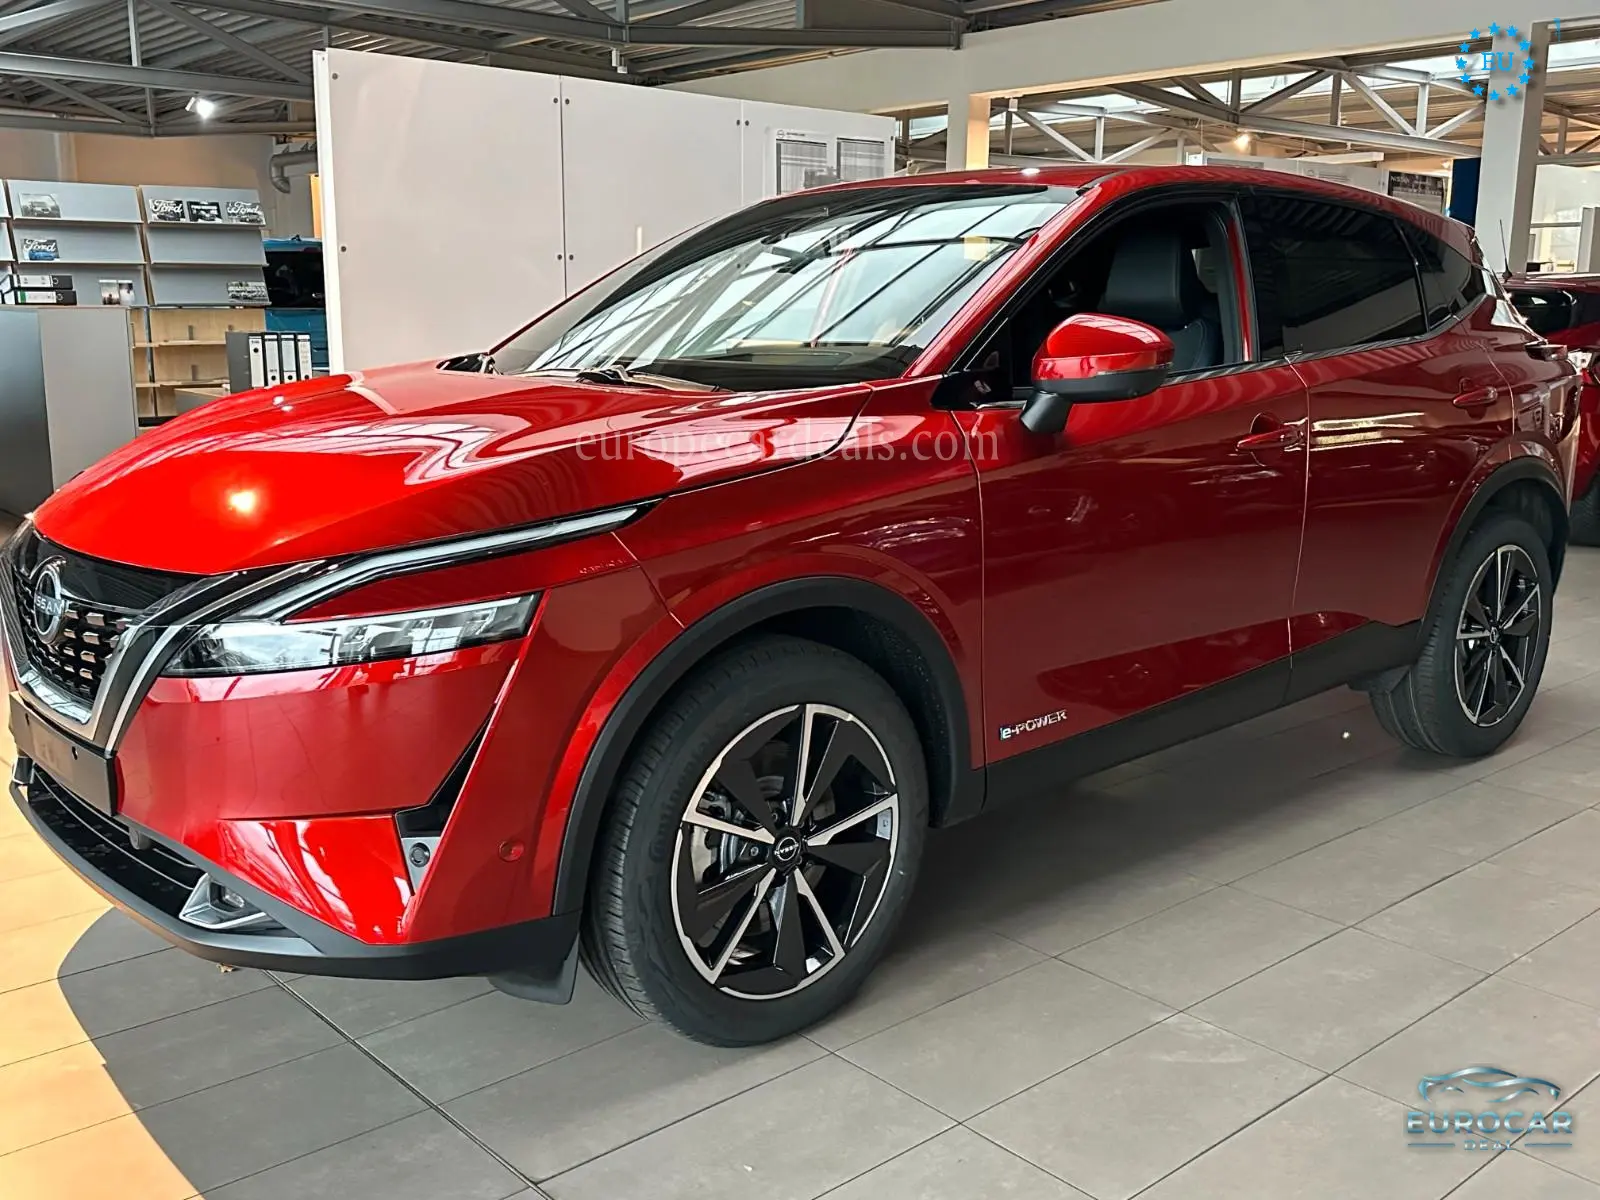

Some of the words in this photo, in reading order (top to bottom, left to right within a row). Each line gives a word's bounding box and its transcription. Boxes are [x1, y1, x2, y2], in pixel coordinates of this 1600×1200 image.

[152, 199, 183, 213] Ford
[227, 201, 261, 214] Ford
[24, 239, 56, 251] Ford
